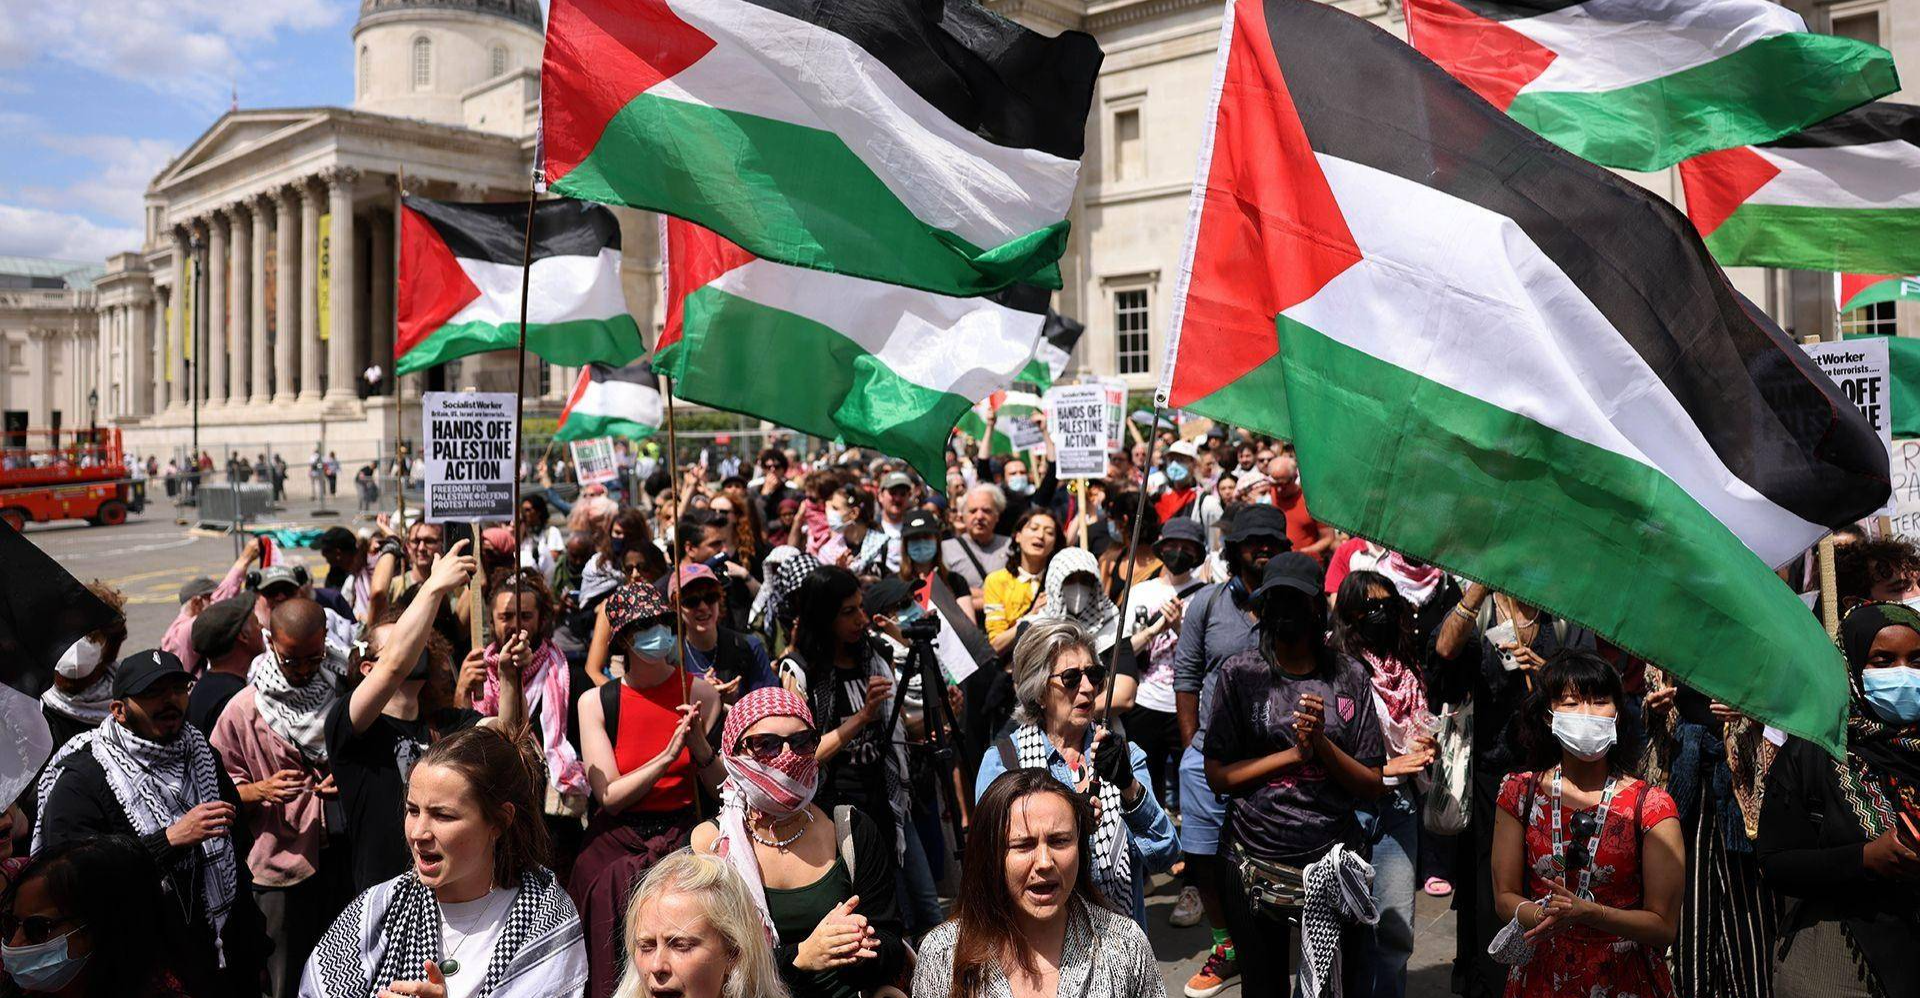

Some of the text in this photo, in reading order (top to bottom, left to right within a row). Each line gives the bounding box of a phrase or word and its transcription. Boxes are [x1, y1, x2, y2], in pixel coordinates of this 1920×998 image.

[1822, 352, 1865, 365] Worker
[1824, 369, 1832, 377] re
[1840, 376, 1882, 405] OFF
[443, 401, 502, 409] Socialist Worker
[1057, 404, 1103, 420] HANDS OFF
[432, 420, 512, 440] HANDS OFF
[1059, 420, 1102, 433] PALESTINE
[1064, 434, 1097, 448] ACTION
[432, 441, 512, 460] PALESTINE
[445, 462, 499, 480] ACTION
[433, 485, 470, 493] FREEDOM
[468, 500, 496, 508] RIGHTS
